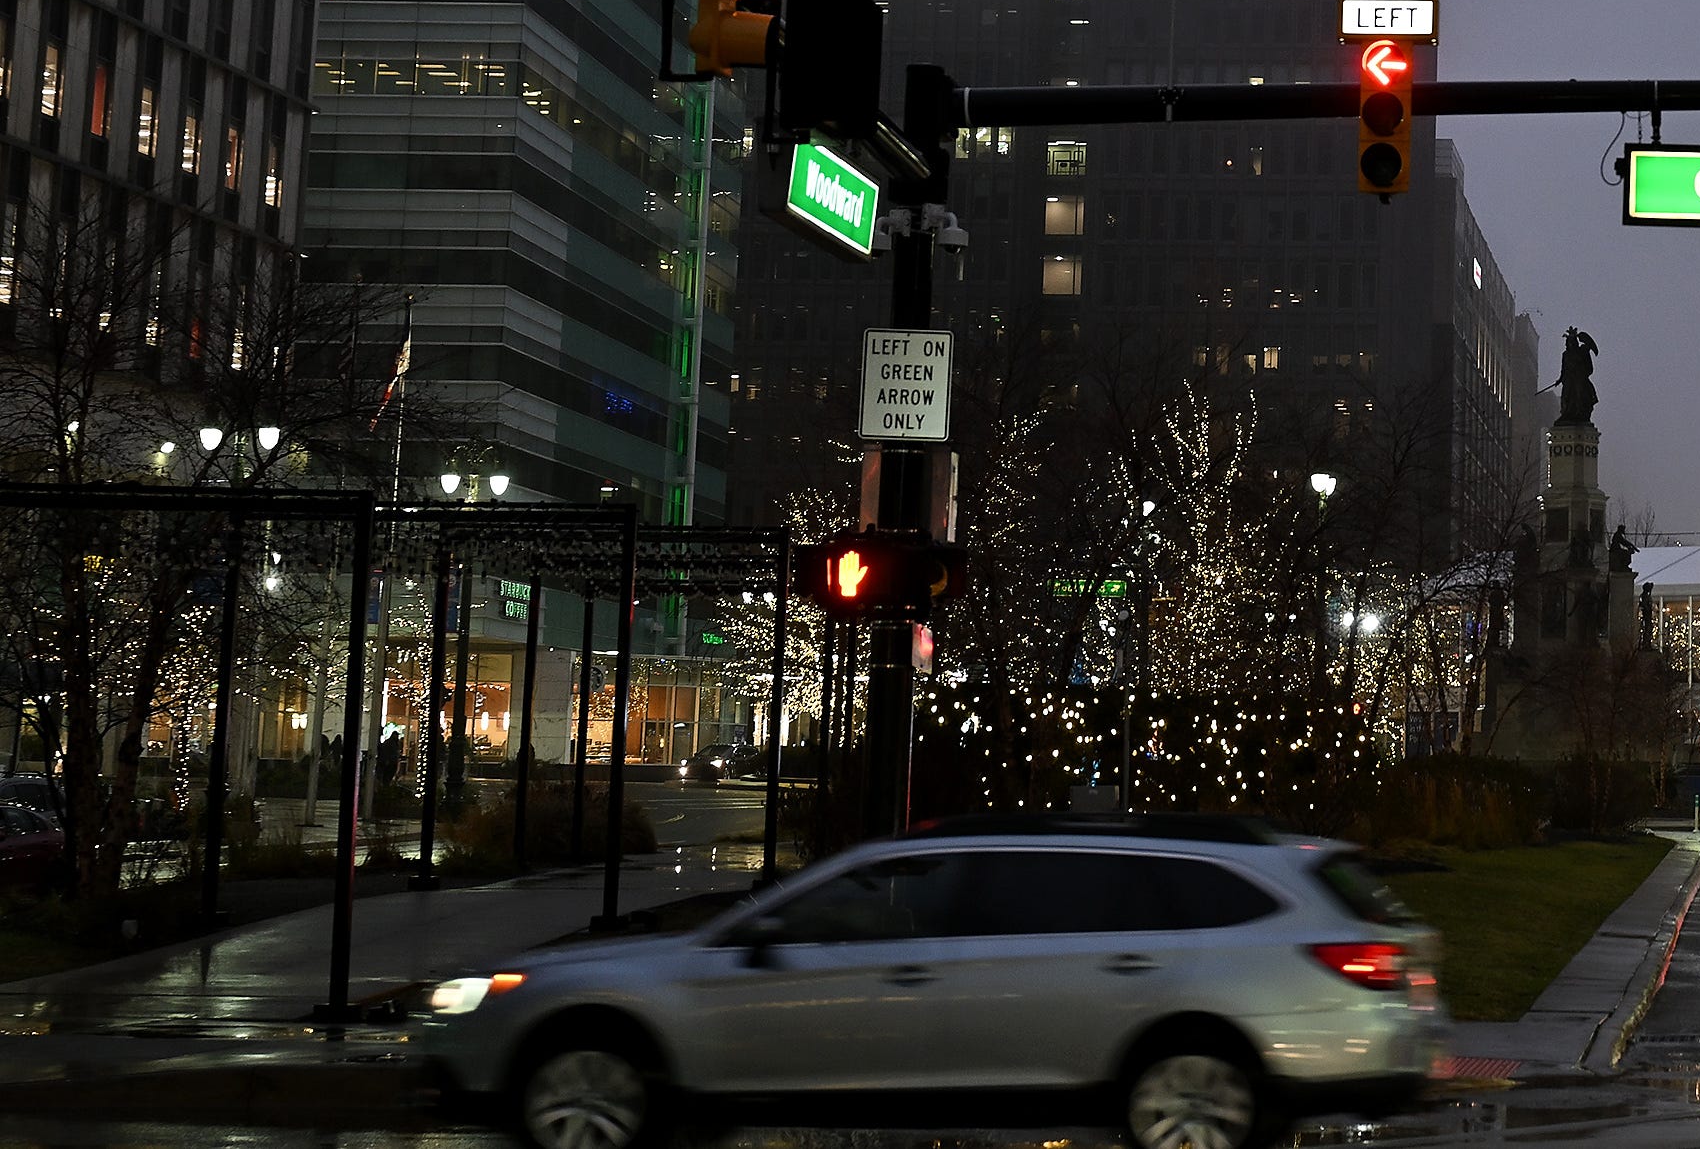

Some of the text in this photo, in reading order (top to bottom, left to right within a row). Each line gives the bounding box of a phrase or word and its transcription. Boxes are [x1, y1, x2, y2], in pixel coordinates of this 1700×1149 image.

[1357, 7, 1418, 28] LEFT
[805, 159, 865, 228] Woodward
[871, 339, 945, 357] LEFT ON
[881, 364, 934, 381] GREEN
[876, 389, 935, 406] ARROW
[883, 413, 926, 430] ONLY
[505, 600, 528, 619] COFFEE
